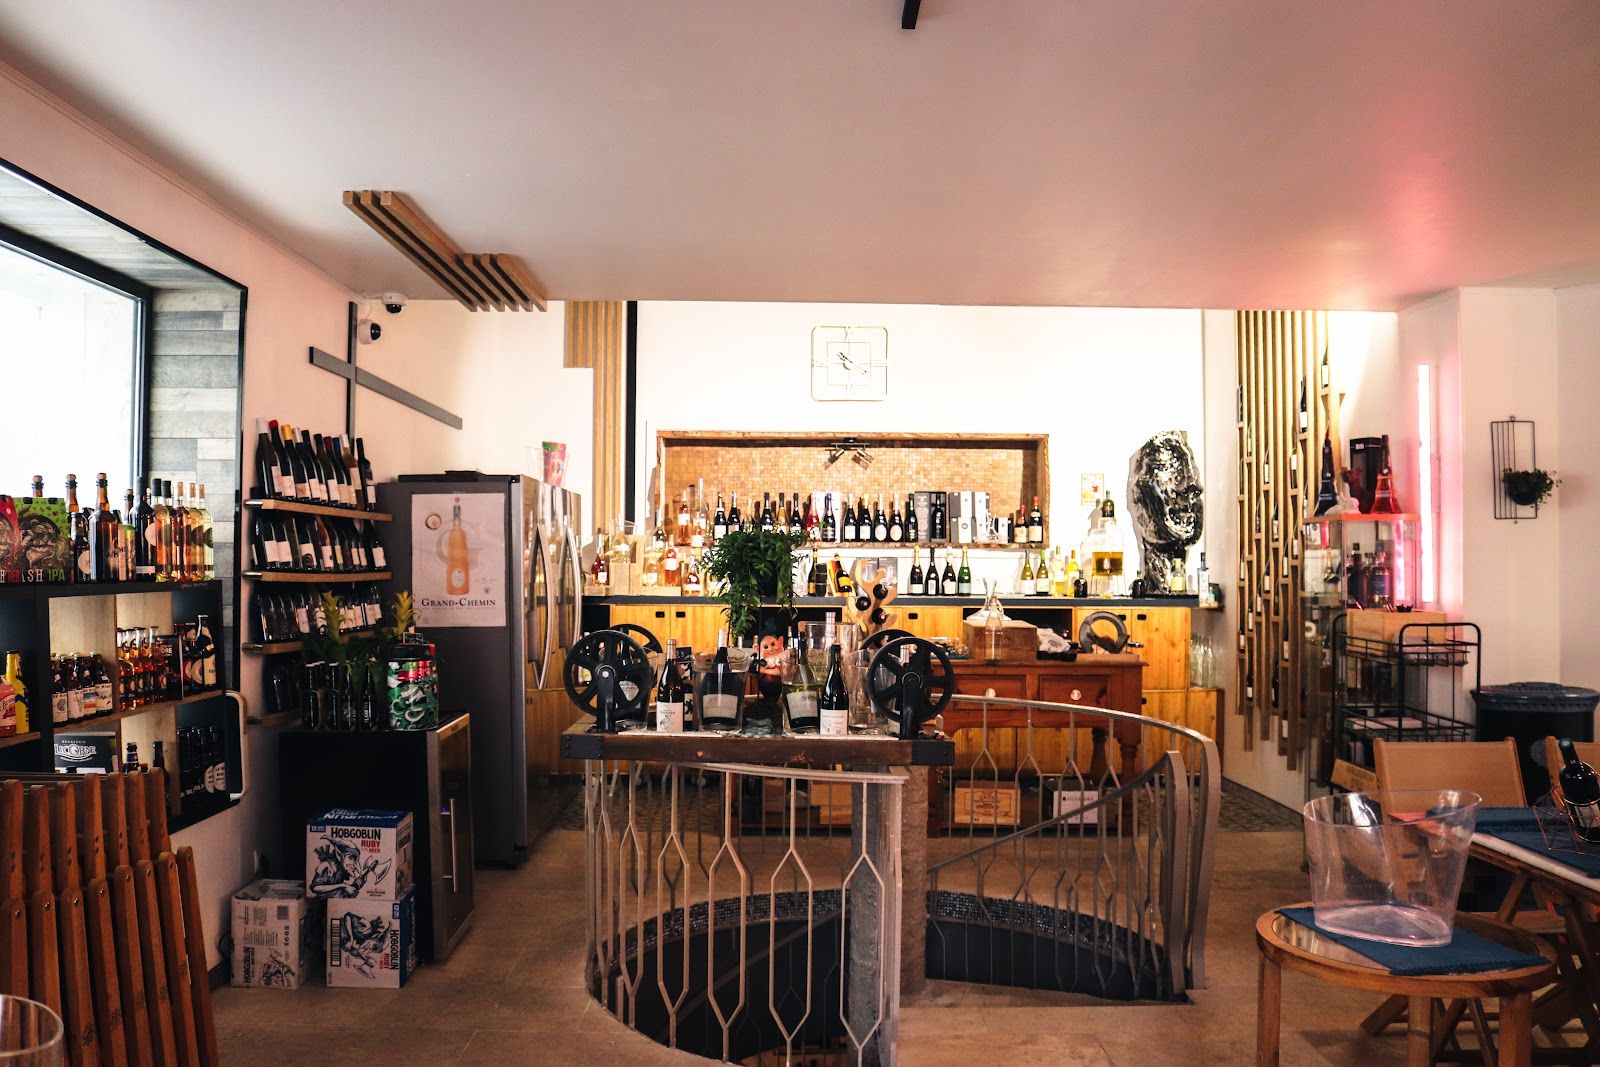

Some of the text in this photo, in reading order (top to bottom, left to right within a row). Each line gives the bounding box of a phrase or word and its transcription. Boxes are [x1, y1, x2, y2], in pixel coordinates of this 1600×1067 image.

[47, 568, 65, 582] IPA
[421, 598, 497, 607] GRAND-CHEMIN
[331, 827, 381, 840] HOBGOBLIN
[361, 840, 381, 848] RUBY
[390, 929, 400, 970] HOBGOBLIN
